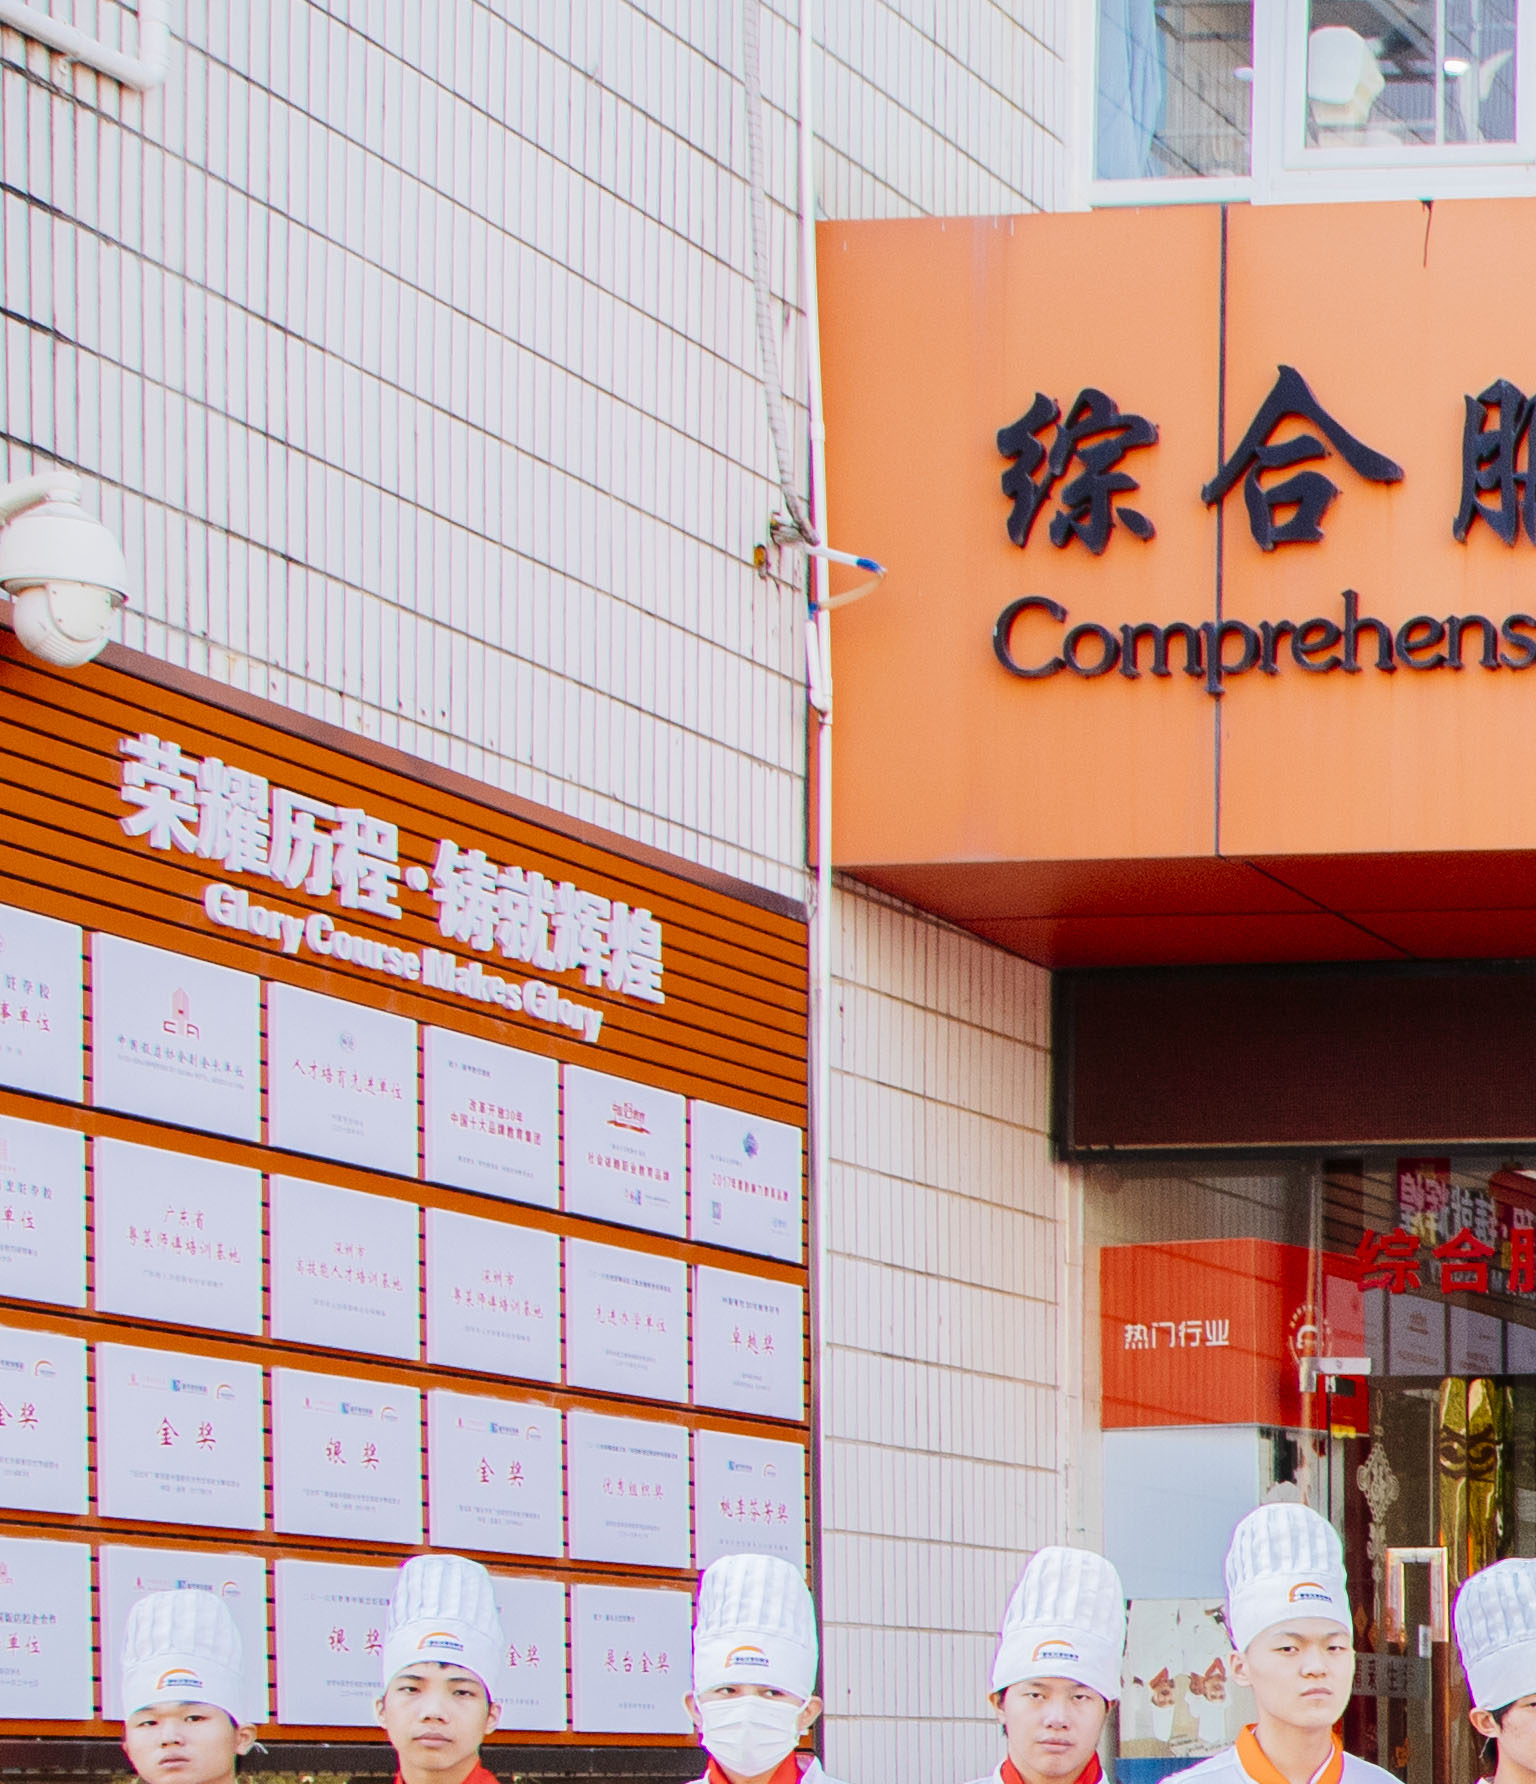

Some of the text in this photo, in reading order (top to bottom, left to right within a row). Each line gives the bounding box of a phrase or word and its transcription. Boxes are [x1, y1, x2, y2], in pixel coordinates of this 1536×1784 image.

[203, 883, 604, 1043] Glory Course Makes Glory
[1123, 1317, 1231, 1351] 热门行业
[156, 1416, 217, 1452] 金奖
[325, 1436, 380, 1471] 银奖
[476, 1456, 525, 1487] 金奖
[328, 1626, 383, 1657] 银奖
[506, 1644, 541, 1669] 金奖
